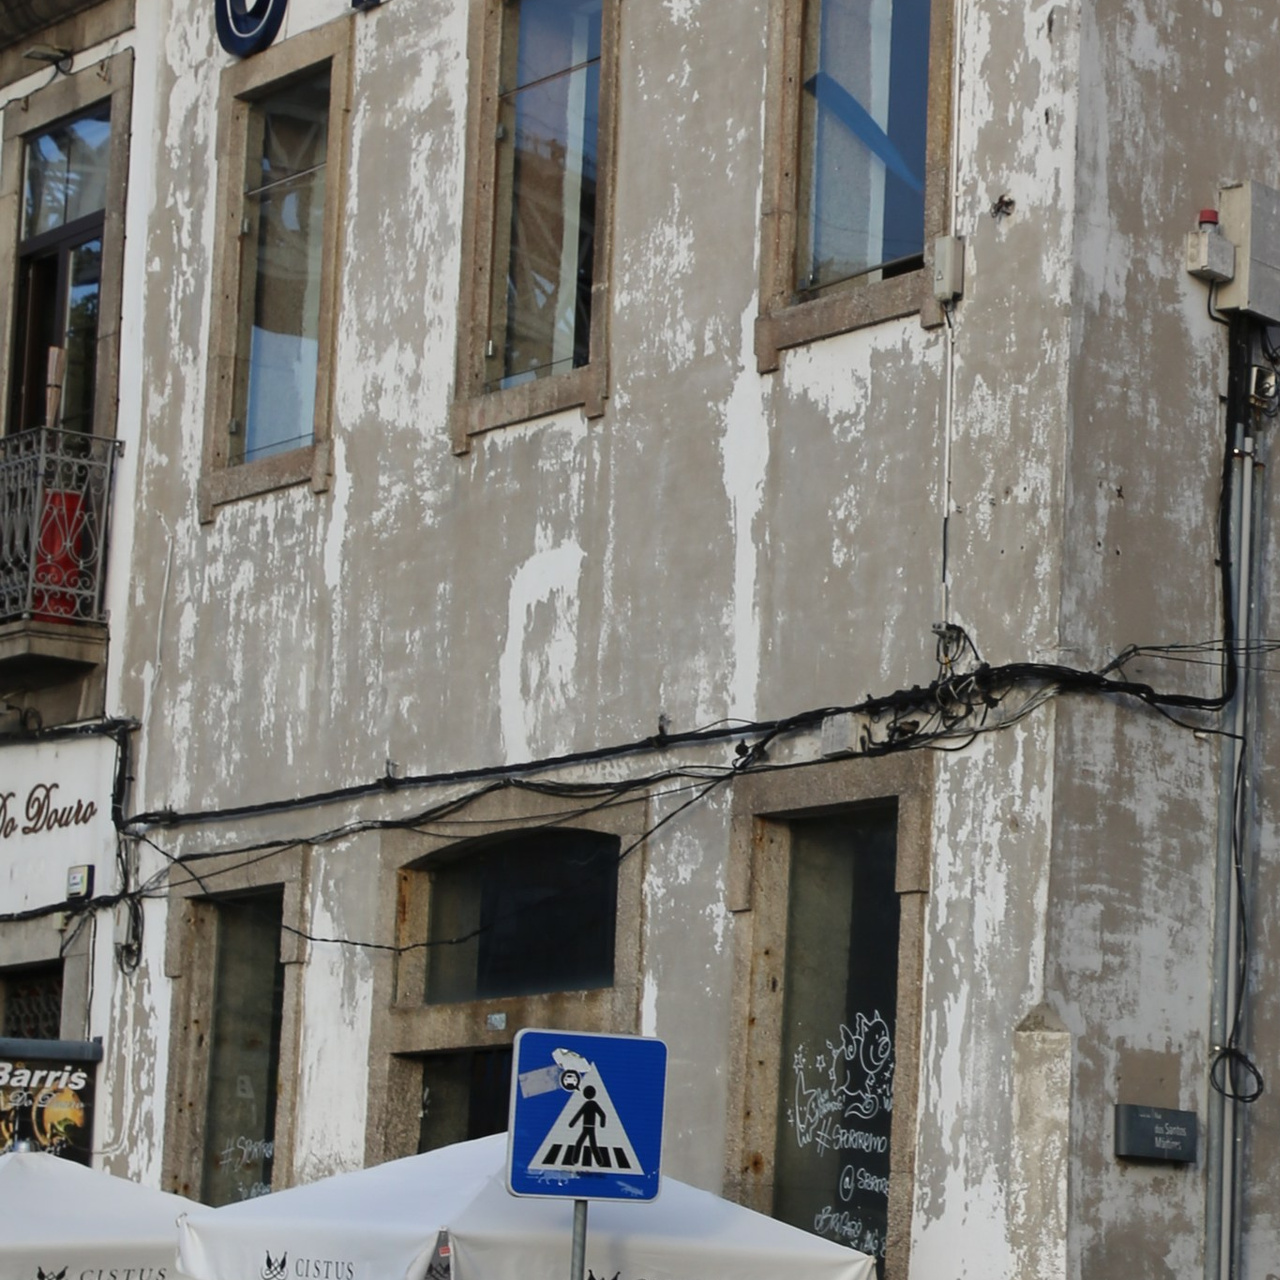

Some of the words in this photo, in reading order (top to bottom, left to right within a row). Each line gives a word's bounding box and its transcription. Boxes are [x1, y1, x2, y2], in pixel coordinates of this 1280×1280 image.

[22, 783, 97, 835] Douro
[1165, 1122, 1187, 1136] Santos
[295, 1257, 354, 1280] CISTUS
